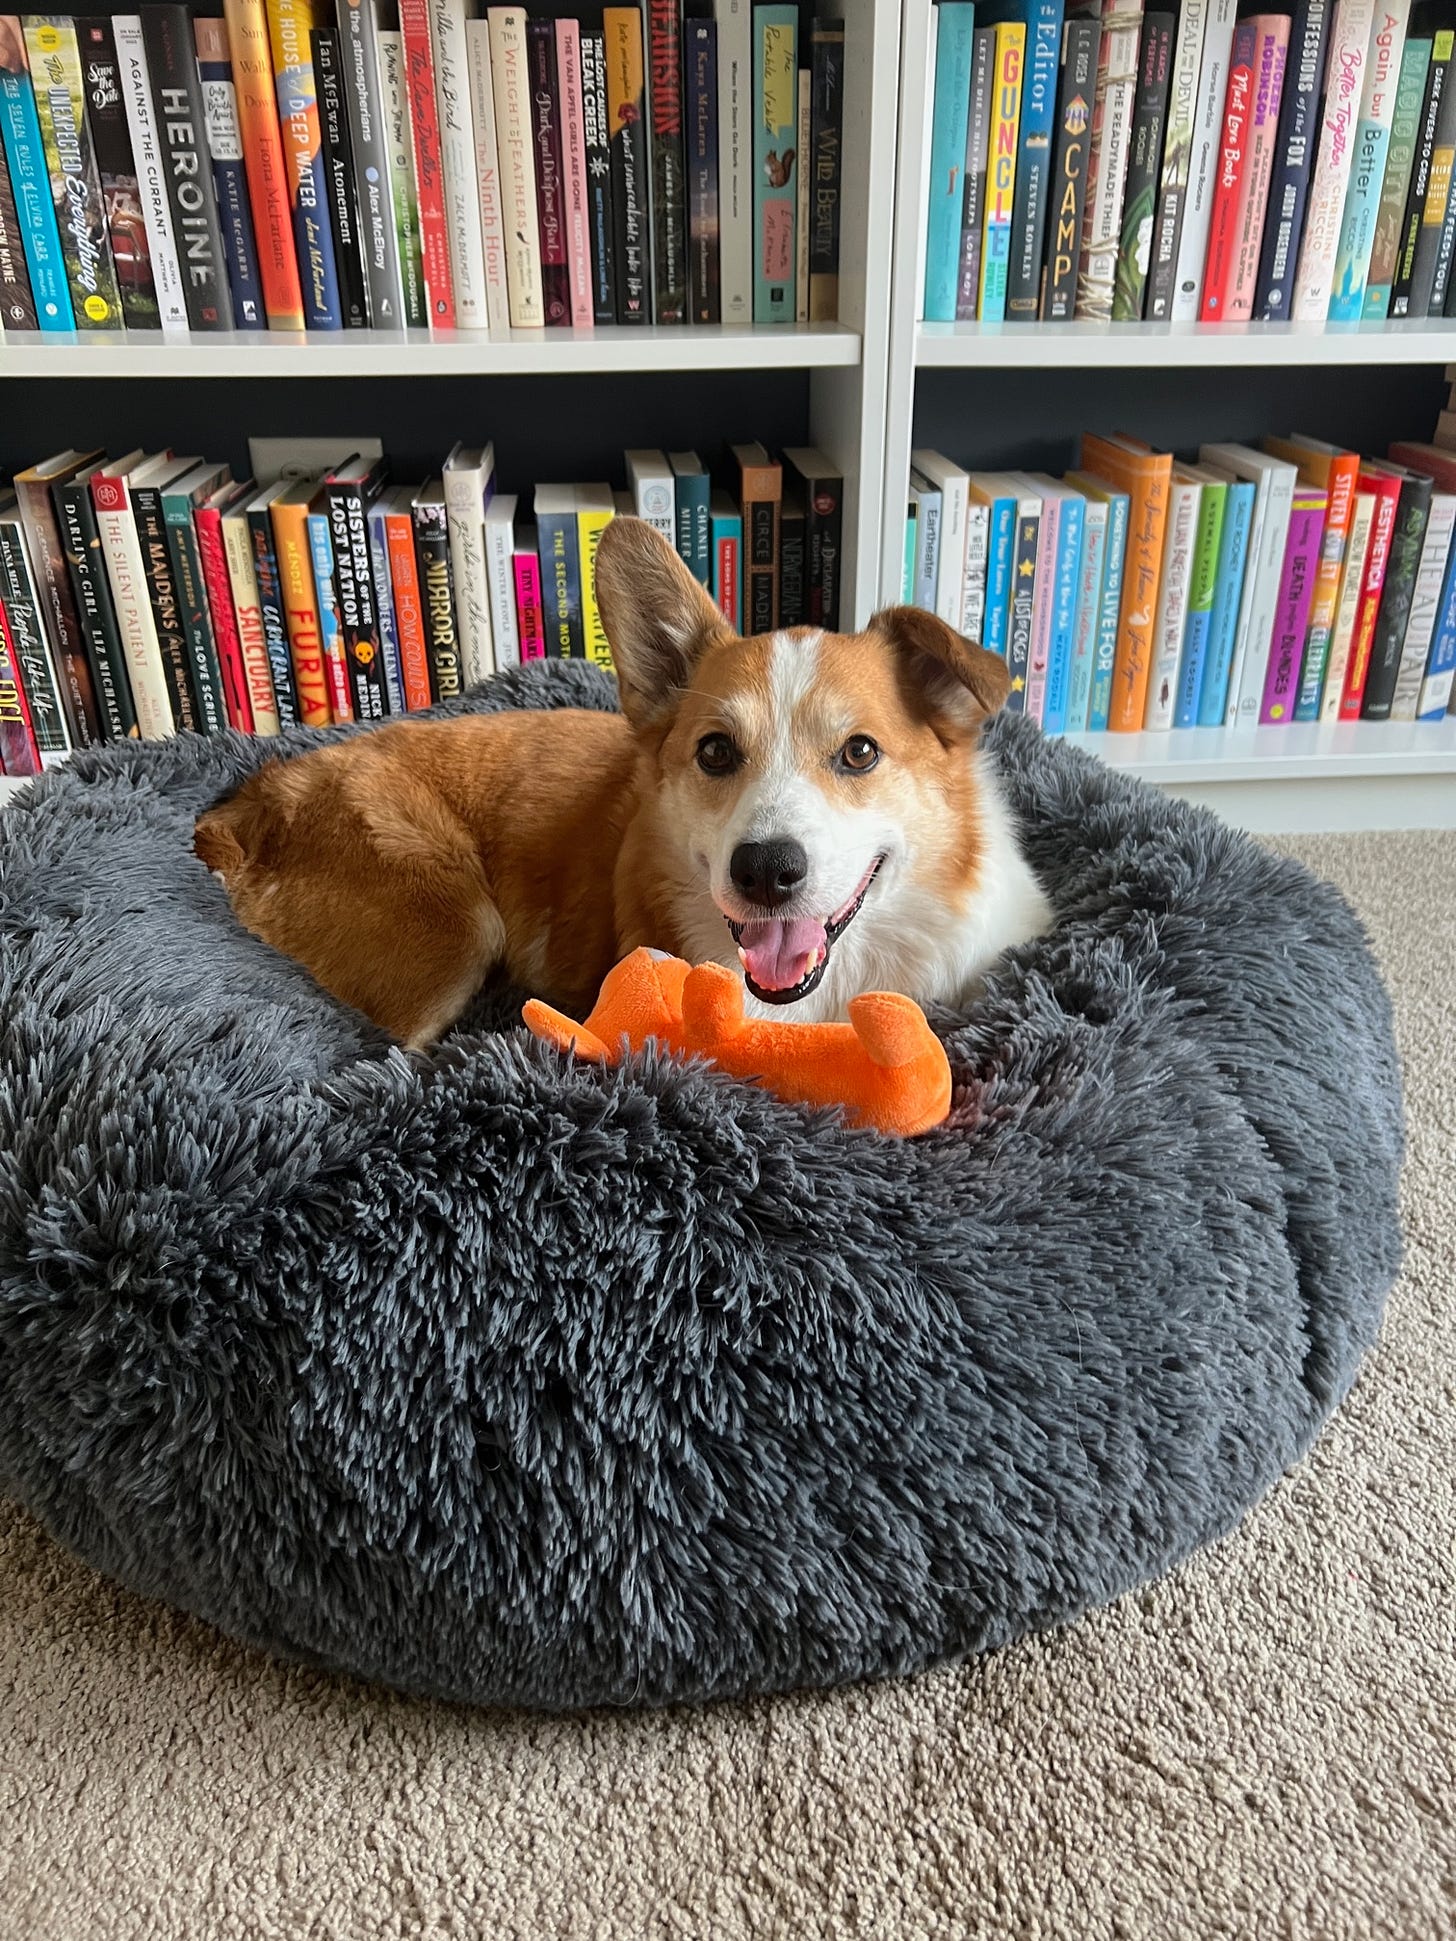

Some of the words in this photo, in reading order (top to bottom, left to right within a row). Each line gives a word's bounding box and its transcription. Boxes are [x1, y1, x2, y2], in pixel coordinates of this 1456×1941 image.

[279, 18, 299, 73] HOUSE
[564, 35, 572, 55] THE
[595, 39, 603, 58] THE
[978, 39, 987, 60] LET
[1182, 2, 1202, 53] DEAL
[1373, 14, 1400, 87] Again,
[44, 56, 63, 84] The
[88, 63, 115, 84] Save
[319, 40, 333, 67] Ian
[350, 10, 372, 141] the_atmospherians
[411, 47, 426, 79] The
[566, 60, 574, 83] VAN
[581, 38, 595, 91] BLEAK
[596, 60, 606, 88] LOST
[697, 51, 708, 86] Kaya
[763, 26, 779, 79] Portable
[977, 67, 985, 83] ME
[1031, 22, 1057, 112] Editor
[1076, 53, 1089, 84] ROSEN
[1339, 45, 1362, 102] Better
[9, 78, 23, 98] THE
[130, 58, 149, 125] AGAINST
[505, 49, 520, 127] WEIGHT
[976, 88, 984, 110] DIE
[1175, 72, 1194, 126] DEVIL
[1209, 62, 1220, 93] Horse
[1231, 72, 1250, 109] Must
[1254, 35, 1275, 126] ROBINSON
[1269, 46, 1286, 116] PHOEBE
[1394, 52, 1425, 138] MAGIC
[1432, 67, 1444, 98] DARK
[10, 104, 25, 138] SEVEN
[288, 99, 308, 141] DEEP
[322, 74, 341, 143] McEwan
[444, 87, 461, 132] Bird
[584, 94, 597, 147] CREEK
[597, 90, 607, 130] CAUSES
[698, 93, 708, 156] McLaren
[975, 114, 982, 127] IN
[1204, 96, 1216, 128] Barbie
[1227, 115, 1245, 144] Love
[1370, 93, 1386, 117] but
[1426, 101, 1439, 140] RIVERS
[48, 87, 82, 173] UNEXPECTED
[142, 133, 154, 160] THE
[569, 123, 579, 153] GIRLS
[599, 133, 608, 148] OF
[816, 128, 837, 181] WILD
[973, 132, 982, 154] HIS
[991, 49, 1020, 256] GUNCLE
[1286, 136, 1306, 166] FOX
[1326, 103, 1351, 169] Together
[1422, 142, 1432, 157] TO
[20, 144, 34, 176] RULES
[297, 151, 316, 207] WATER
[418, 125, 434, 188] Dwellers
[571, 156, 580, 176] ARE
[665, 155, 673, 196] JAMES
[1105, 113, 1123, 198] READYMADE
[1222, 149, 1242, 187] Books
[1356, 129, 1382, 198] Better
[1383, 146, 1410, 207] CITY
[1416, 160, 1429, 196] CROSS
[147, 167, 167, 238] CURRANT
[162, 89, 214, 286] HEROINE
[226, 171, 242, 210] KATIE
[258, 138, 273, 181] Fiona
[266, 187, 286, 269] McFarlane
[332, 157, 350, 244] Atonement
[368, 185, 381, 213] Alex
[479, 168, 496, 226] Ninth
[509, 139, 527, 229] FEATHERS
[572, 179, 582, 211] GONE
[623, 164, 640, 242] unbreakable
[968, 157, 979, 225] FOOTSTEPS
[1027, 165, 1040, 218] STEVEN
[1165, 194, 1178, 216] KIT
[28, 194, 43, 227] ELVIRA
[66, 175, 99, 292] Everything
[399, 186, 414, 257] CHRISTOPHER
[816, 189, 837, 256] BEAUTY
[1053, 143, 1082, 287] CAMP
[1101, 204, 1113, 239] THIEF
[1312, 201, 1329, 252] RICCIO
[1322, 185, 1342, 261] CHRISTINE
[35, 233, 48, 261] CARR
[370, 217, 386, 269] McElroy
[484, 235, 499, 287] Hour
[966, 236, 974, 265] LORI
[1022, 225, 1036, 280] ROWLEY
[1159, 219, 1176, 261] ROCHA
[1438, 218, 1456, 258] FEEDS
[1, 248, 15, 283] MAYNE
[158, 252, 169, 293] MATTHEWS
[168, 260, 177, 285] OLIVIA
[309, 248, 327, 310] McFarland
[963, 272, 971, 296] ROY
[1435, 261, 1447, 289] YOU
[329, 497, 348, 546] LOST
[1331, 473, 1352, 524] STEVEN
[105, 516, 123, 544] THE
[146, 516, 159, 536] THE
[346, 498, 369, 580] SISTERS
[496, 536, 504, 556] THE
[554, 530, 564, 556] THE
[680, 507, 692, 557] MILLER
[696, 505, 708, 560] CHANEL
[755, 510, 770, 558] CIRCE
[923, 509, 939, 580] Eartheater
[1109, 501, 1125, 569] SOMETHING
[1366, 496, 1394, 591] AESTHETICA
[64, 504, 89, 574] DARLING
[80, 580, 98, 617] GIRL
[112, 552, 134, 602] SILENT
[286, 540, 303, 595] MÉNDEZ
[497, 560, 507, 596] WINTER
[781, 537, 802, 614] NORWEGIAN
[1289, 555, 1308, 601] DEATH
[1321, 528, 1343, 580] ROWLEY
[1424, 528, 1451, 579] THE
[6, 570, 22, 597] MELE
[148, 542, 177, 629] MAIDENS
[337, 553, 359, 626] NATION
[359, 585, 369, 599] OF
[375, 573, 392, 633] WONDERS
[426, 560, 454, 645] MIRROR
[556, 562, 568, 618] SECOND
[361, 602, 372, 625] THE
[500, 600, 510, 633] PEOPLE
[964, 610, 977, 632] ARE
[990, 606, 1002, 639] Taylor
[1102, 591, 1120, 627] LIVE
[1314, 599, 1333, 625] THE
[1410, 594, 1438, 625] AU
[9, 604, 35, 649] People
[22, 655, 45, 686] Like
[125, 609, 147, 668] PATIENT
[238, 605, 274, 713] SANCTUARY
[262, 604, 291, 693] CORMORANT
[1053, 634, 1064, 664] MAYA
[1098, 632, 1115, 670] FOR
[92, 630, 105, 654] LIZ
[100, 660, 122, 740] MICHALSKI
[290, 609, 326, 718] FURIA
[1301, 627, 1329, 705] CELEBRANTS
[1395, 642, 1427, 703] PAIR
[194, 646, 210, 680] LOVE
[202, 684, 218, 731] SCRIBE
[370, 684, 382, 717] NICK
[1049, 668, 1061, 712] RODALE
